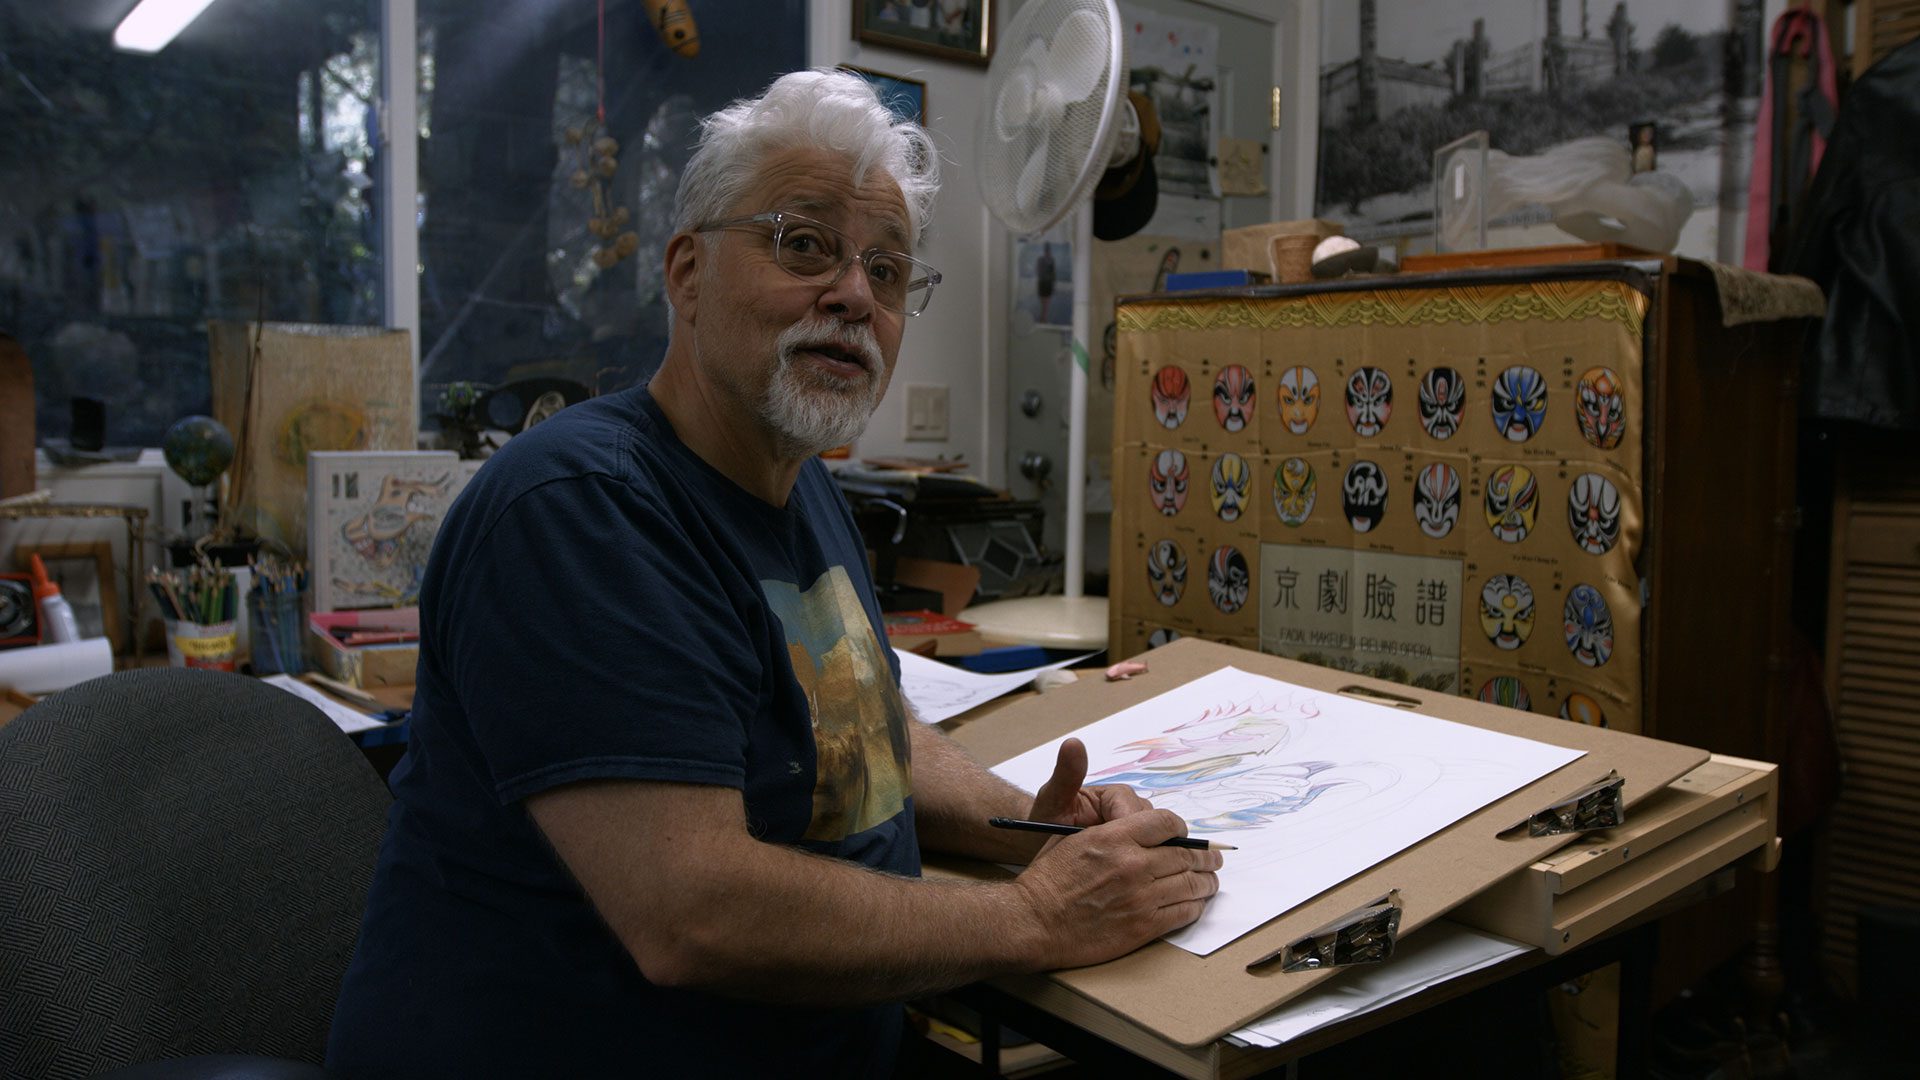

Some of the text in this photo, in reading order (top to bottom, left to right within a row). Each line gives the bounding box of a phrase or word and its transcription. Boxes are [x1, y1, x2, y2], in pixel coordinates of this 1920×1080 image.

[1273, 565, 1448, 627] 京劇臉譜
[1400, 641, 1433, 661] OPERA
